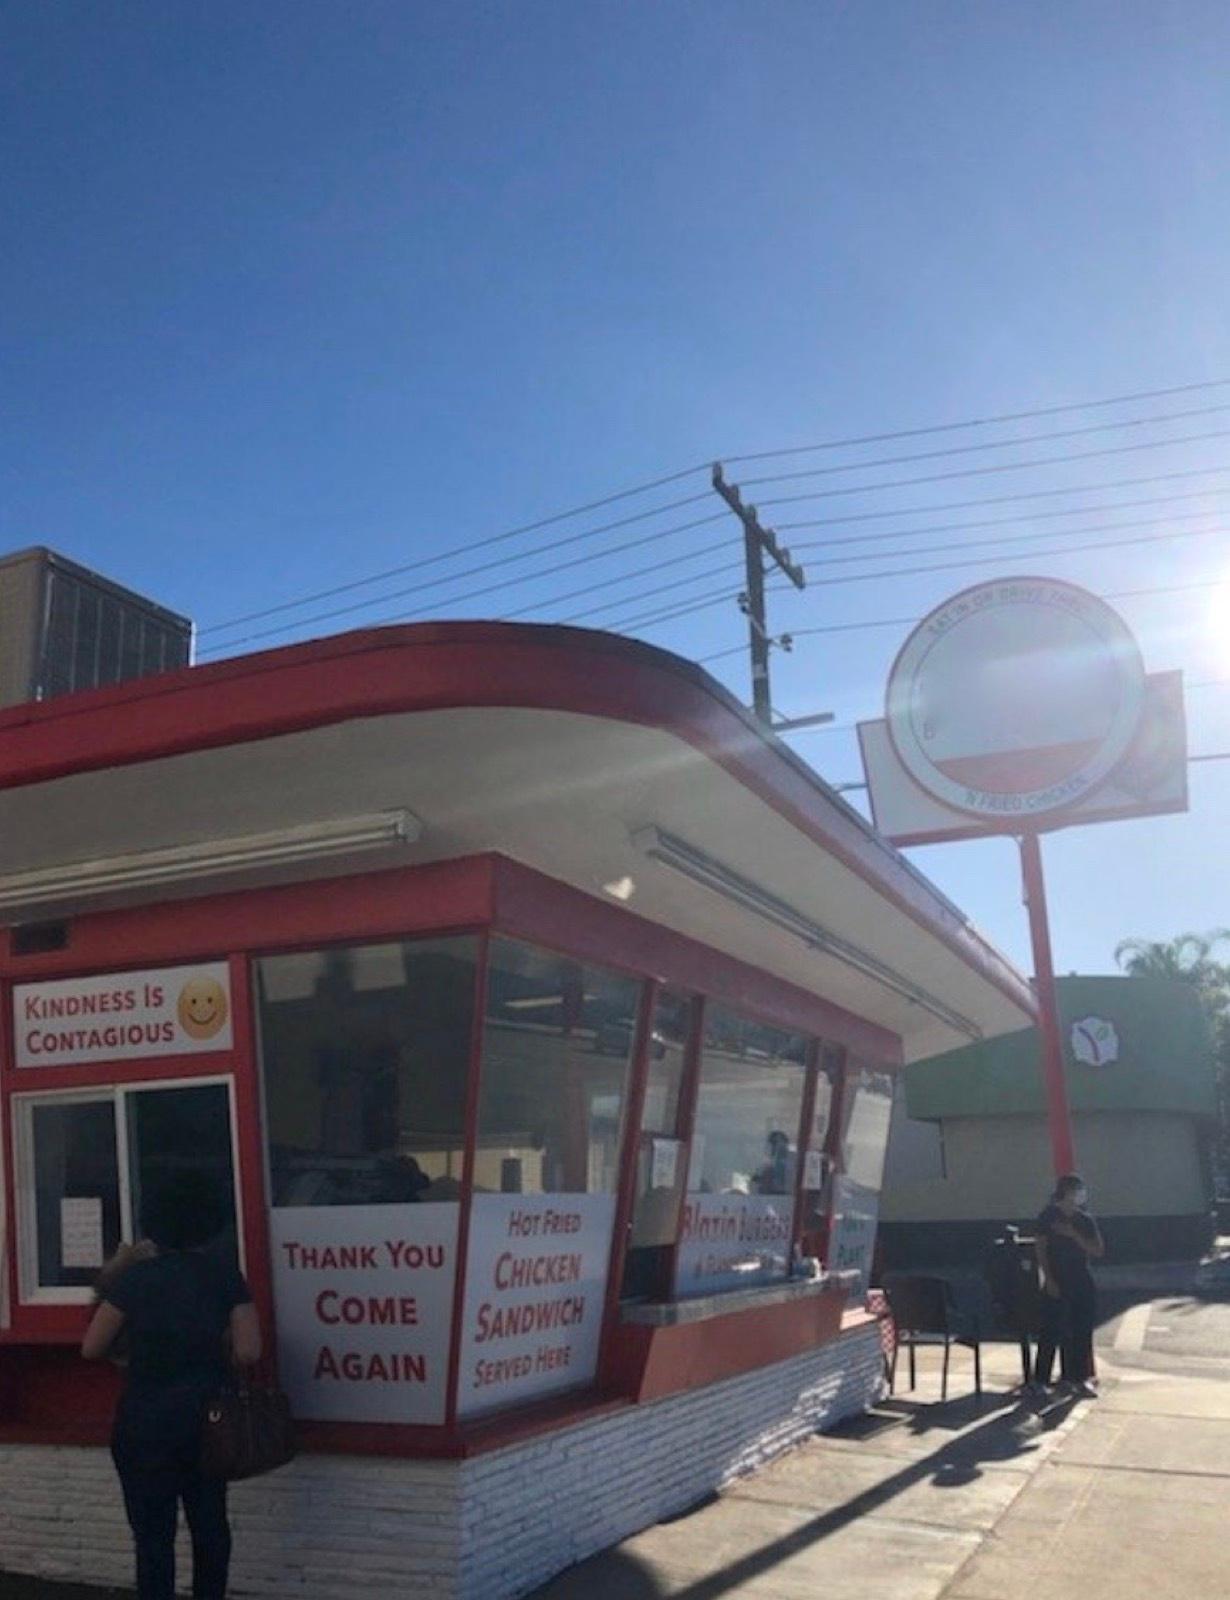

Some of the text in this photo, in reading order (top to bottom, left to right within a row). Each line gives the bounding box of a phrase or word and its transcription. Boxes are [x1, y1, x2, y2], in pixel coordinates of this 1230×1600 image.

[25, 983, 164, 1020] KINDNESS IS
[26, 1021, 175, 1054] CONTAGIOUS
[508, 1208, 581, 1236] HOT FRIED
[282, 1240, 445, 1271] THANK YOU
[494, 1251, 582, 1291] CHICKEN
[315, 1289, 418, 1326] COME
[474, 1297, 585, 1344] SANDWICH
[312, 1345, 427, 1383] AGAIN
[473, 1345, 572, 1389] SERVED HERE
